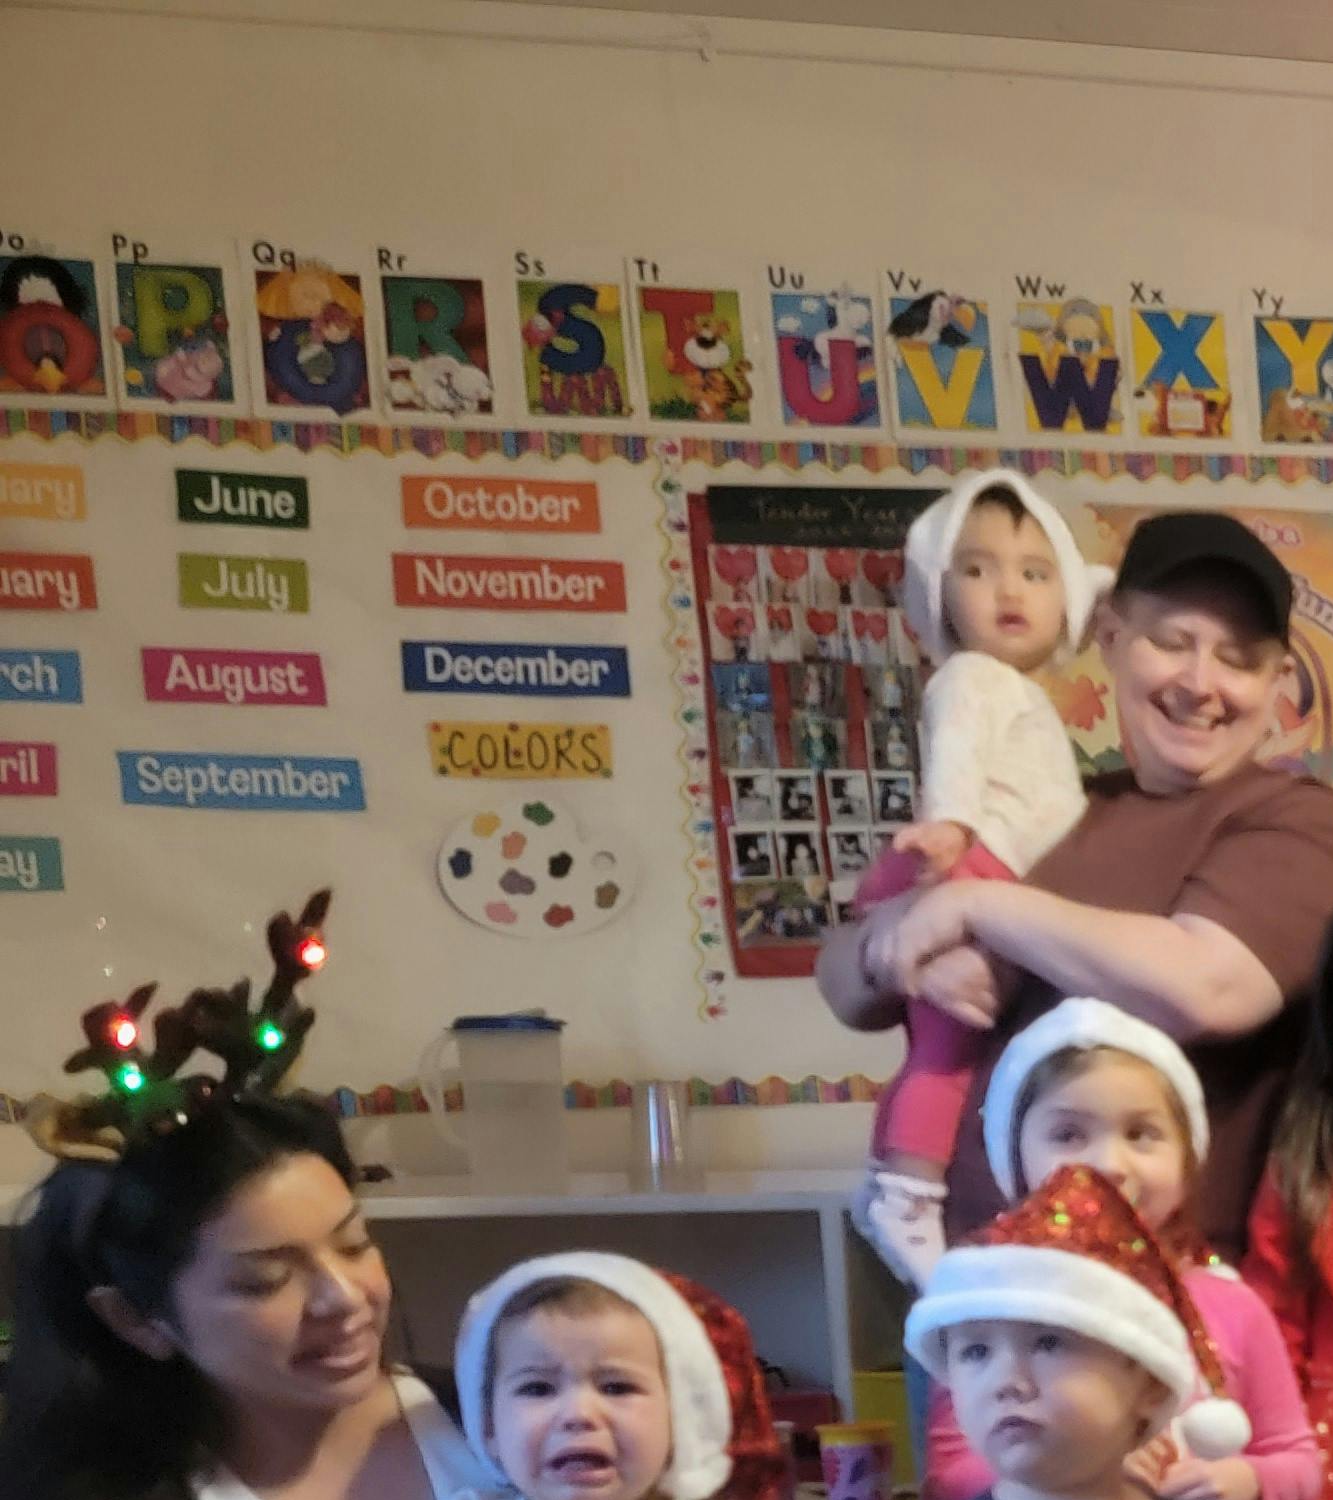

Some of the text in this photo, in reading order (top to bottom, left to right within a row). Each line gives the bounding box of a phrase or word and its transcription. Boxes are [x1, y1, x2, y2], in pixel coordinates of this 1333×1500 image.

[112, 233, 149, 264] Pp
[252, 240, 296, 273] Qq
[376, 246, 407, 272] Rr
[514, 251, 546, 278] Ss
[634, 258, 660, 282] Tt
[768, 264, 804, 289] Uu
[887, 270, 922, 293] Vv
[1015, 275, 1066, 298] Ww
[1129, 281, 1165, 305] Xx
[1252, 287, 1284, 318] Yy
[193, 475, 296, 519] June
[423, 481, 581, 523] October
[202, 560, 290, 611] July
[414, 558, 606, 603] November
[164, 653, 309, 703] August
[423, 646, 610, 688] December
[449, 730, 604, 773] COLORS
[136, 755, 350, 805] September
